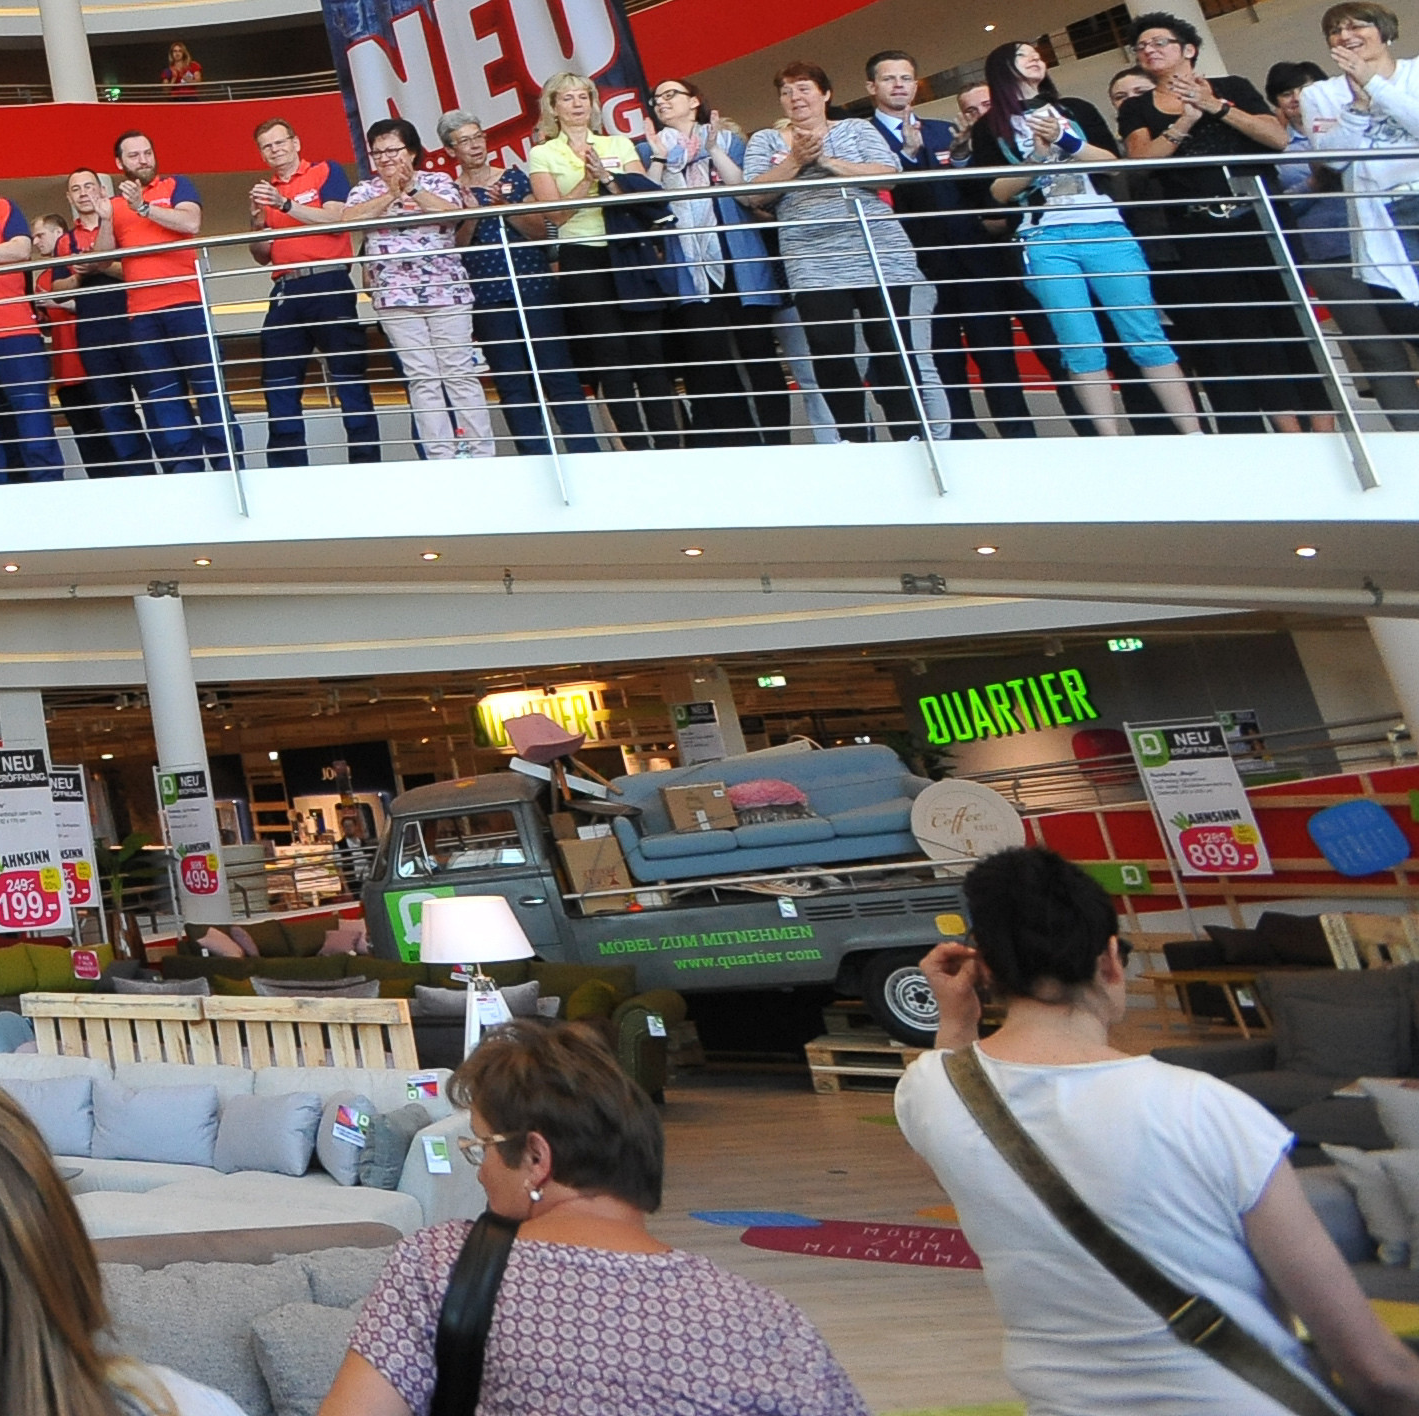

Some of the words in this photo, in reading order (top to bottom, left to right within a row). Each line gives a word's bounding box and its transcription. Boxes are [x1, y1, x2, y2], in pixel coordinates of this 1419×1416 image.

[919, 668, 1098, 744] QUARTIER
[1173, 731, 1210, 746] NEU
[1, 755, 35, 772] NEU
[180, 776, 199, 786] NEU
[1170, 809, 1241, 830] WAHNSINN
[1188, 844, 1254, 866] 899.-
[598, 938, 657, 955] MÖBEL
[661, 934, 698, 950] ZUM
[701, 925, 814, 946] MITNEHMEN
